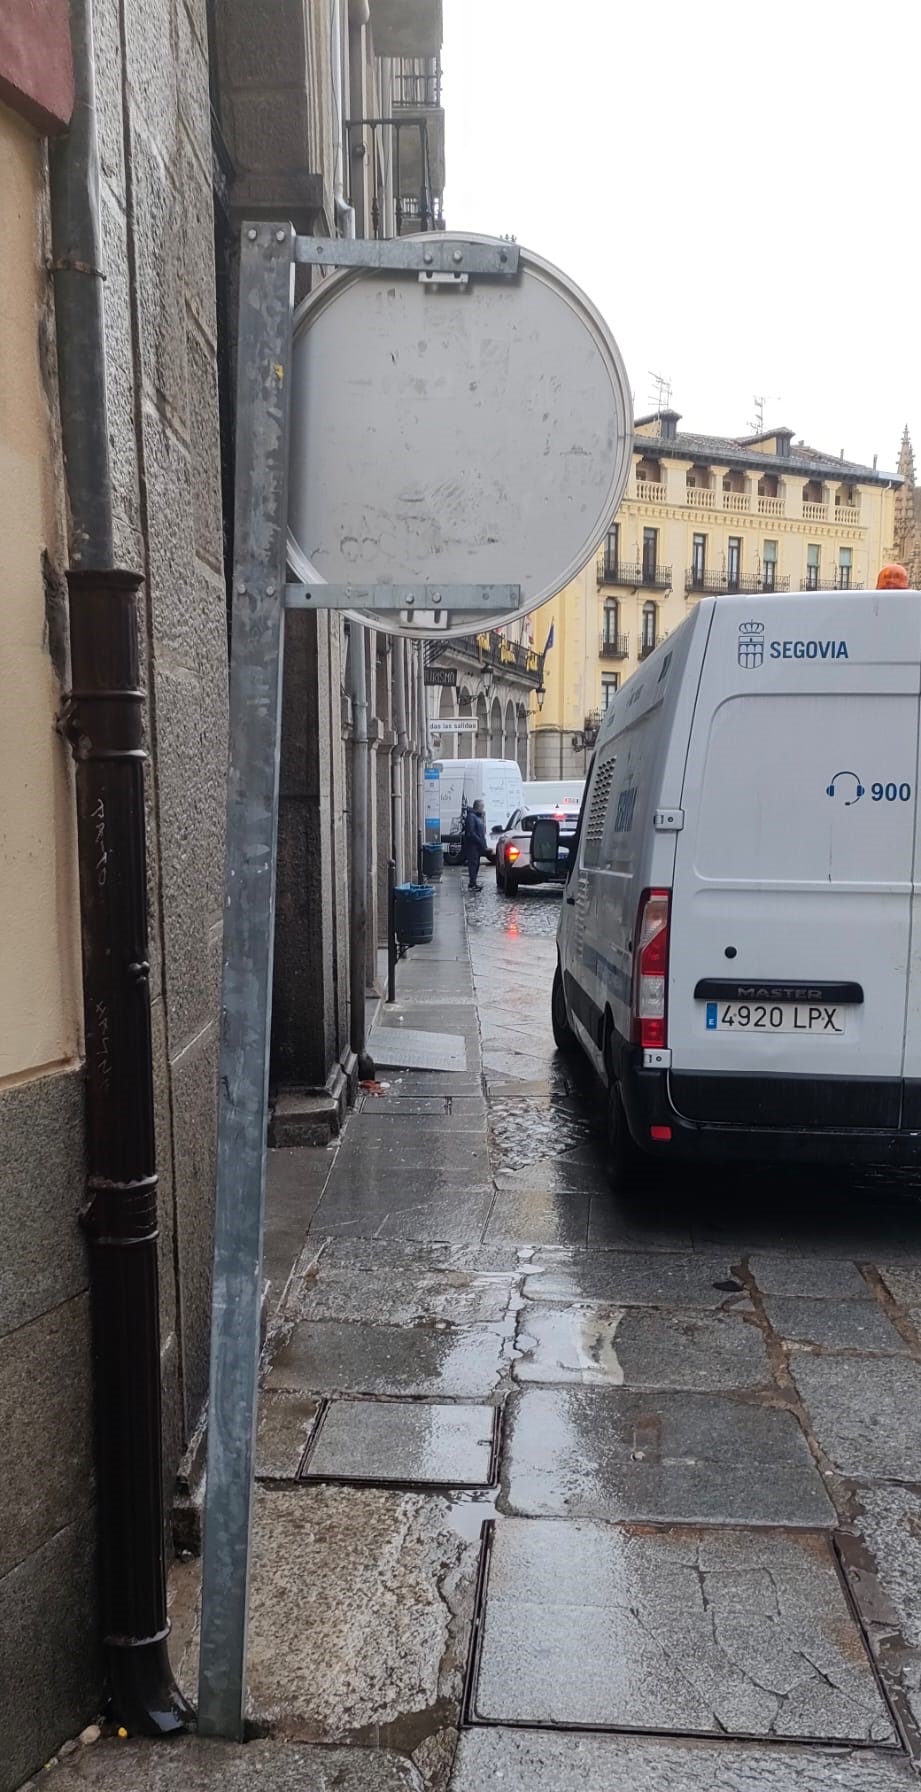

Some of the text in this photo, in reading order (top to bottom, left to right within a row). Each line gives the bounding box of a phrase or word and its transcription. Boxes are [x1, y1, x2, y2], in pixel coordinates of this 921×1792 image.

[769, 641, 849, 659] SEGOVIA
[871, 782, 911, 802] 900
[737, 987, 823, 1000] MASTER
[708, 1004, 838, 1031] E 4920 LPX
